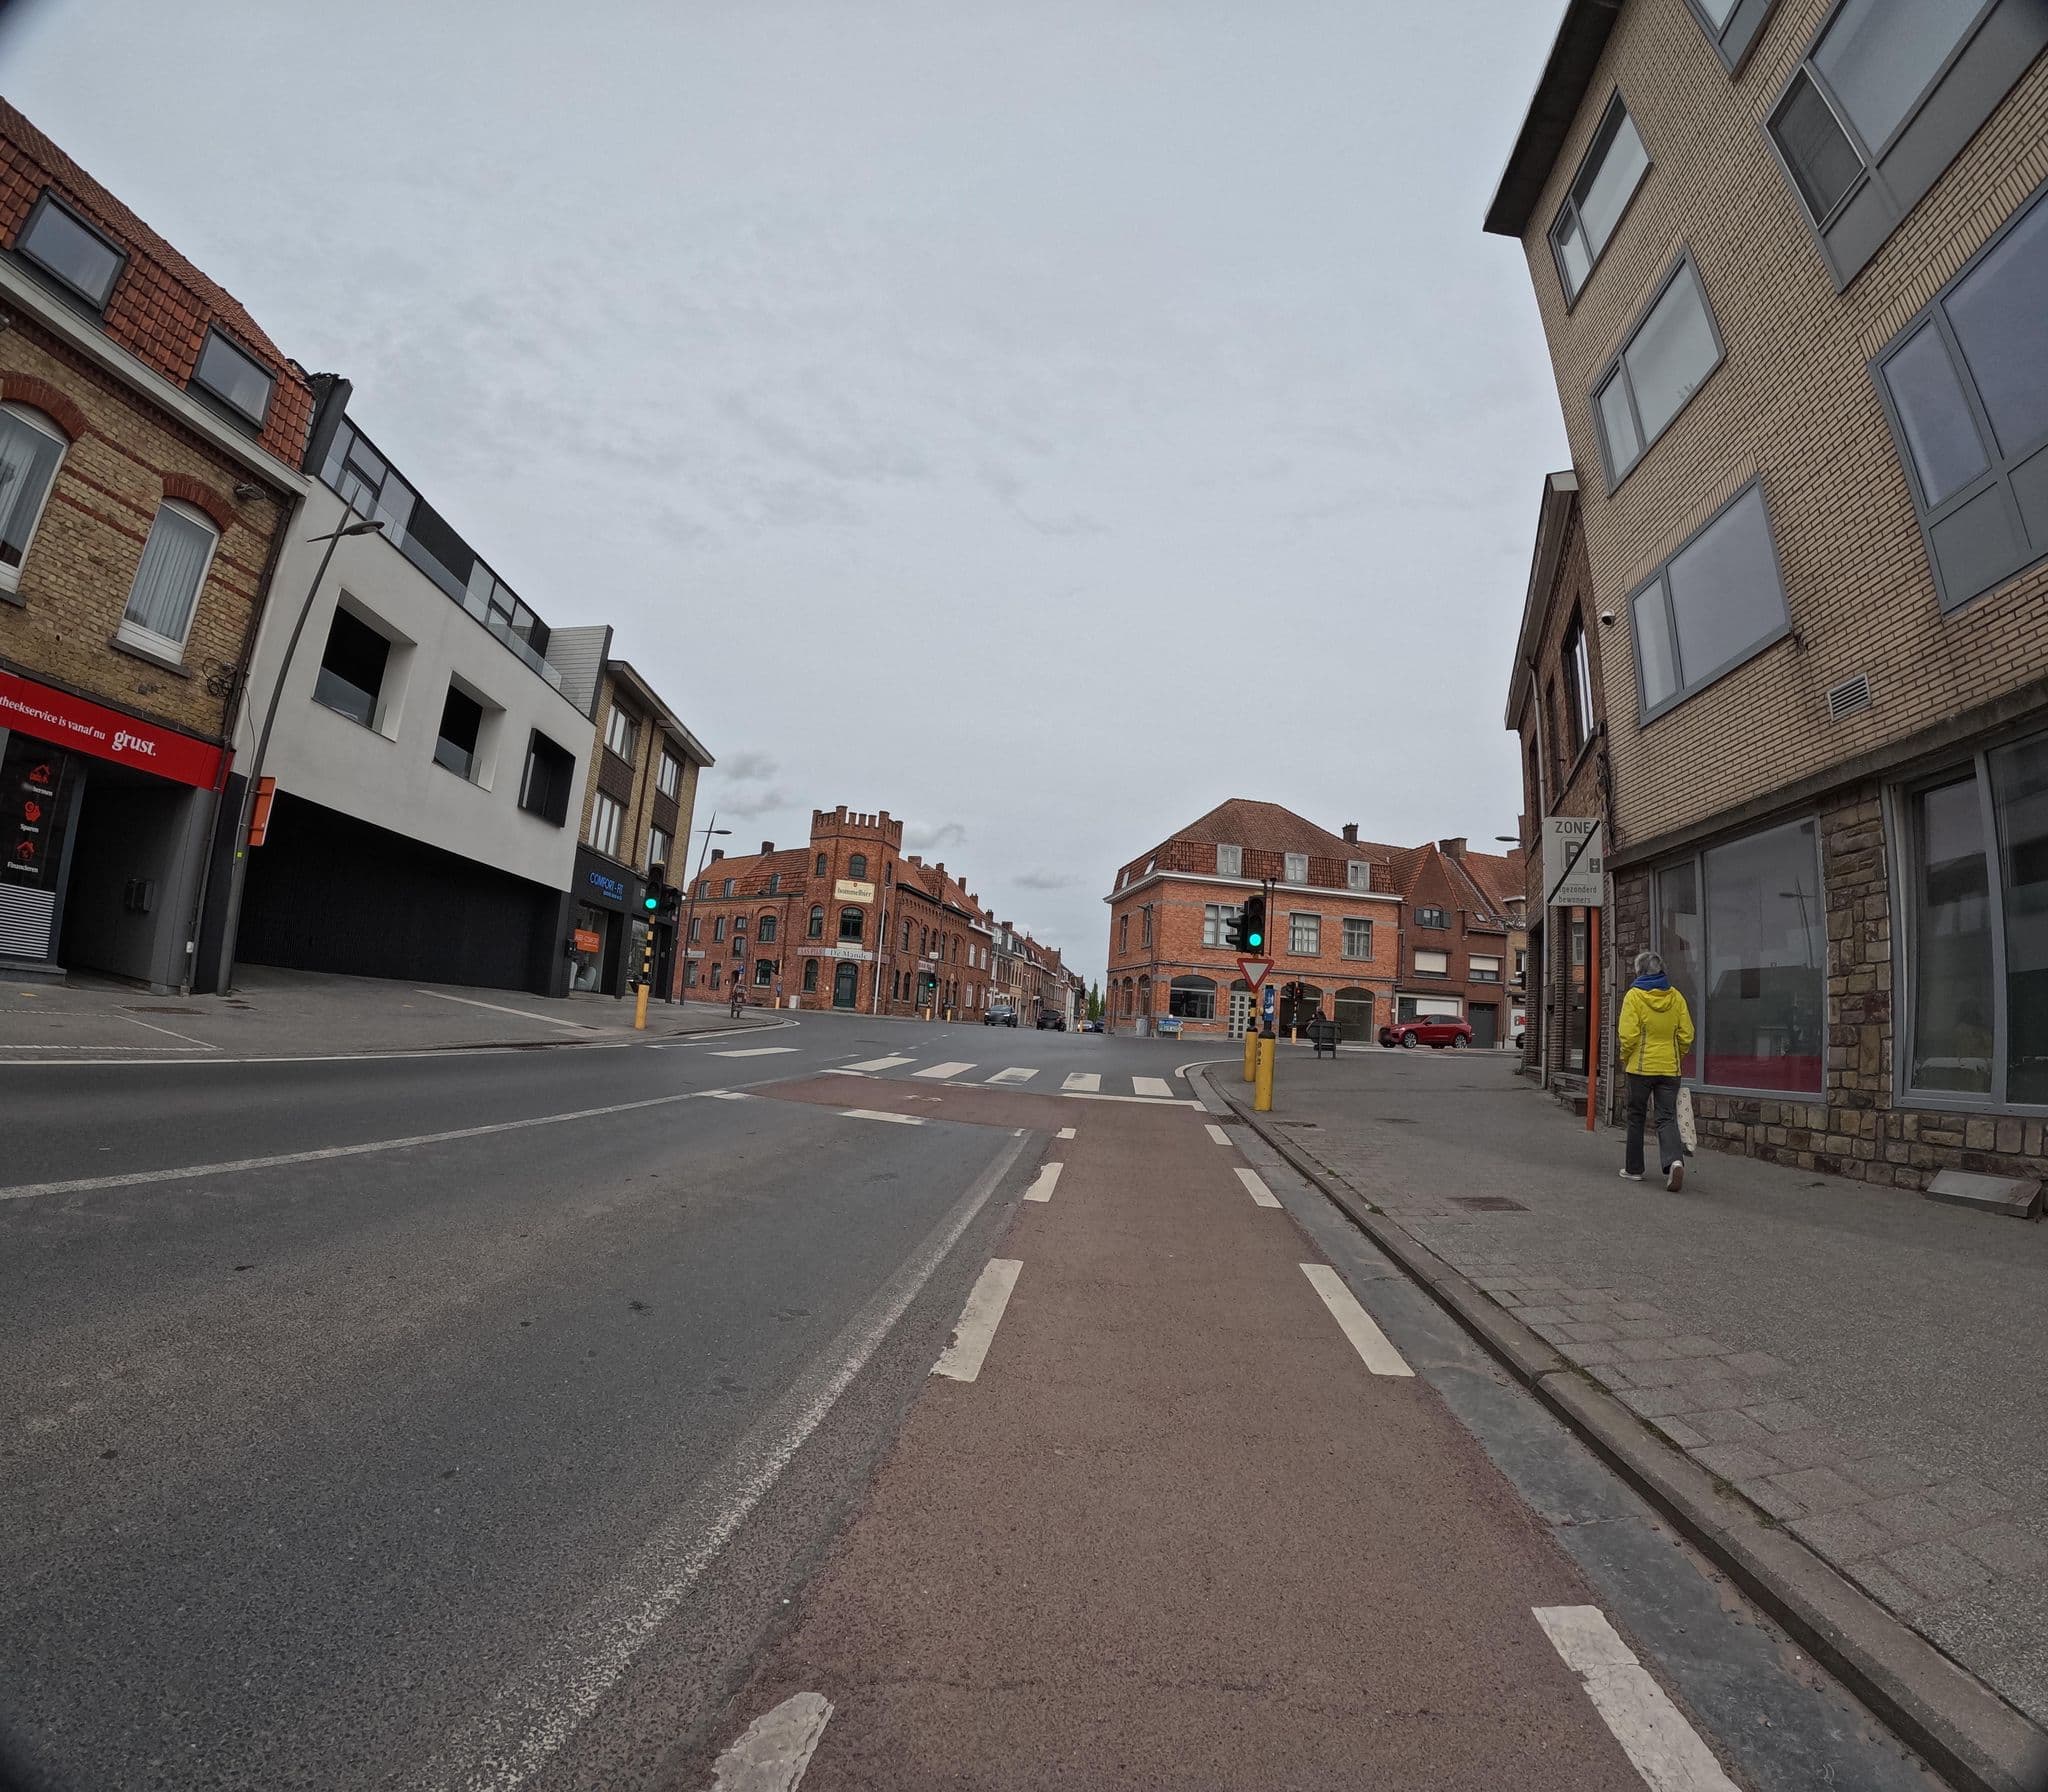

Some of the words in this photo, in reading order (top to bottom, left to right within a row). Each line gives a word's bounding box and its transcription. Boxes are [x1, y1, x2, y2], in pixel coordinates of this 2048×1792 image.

[58, 716, 67, 727] is
[68, 720, 93, 736] vanaf
[94, 730, 106, 740] nu
[112, 730, 157, 757] grust.
[1555, 821, 1591, 834] ZONE
[1553, 886, 1597, 894] gezonderd
